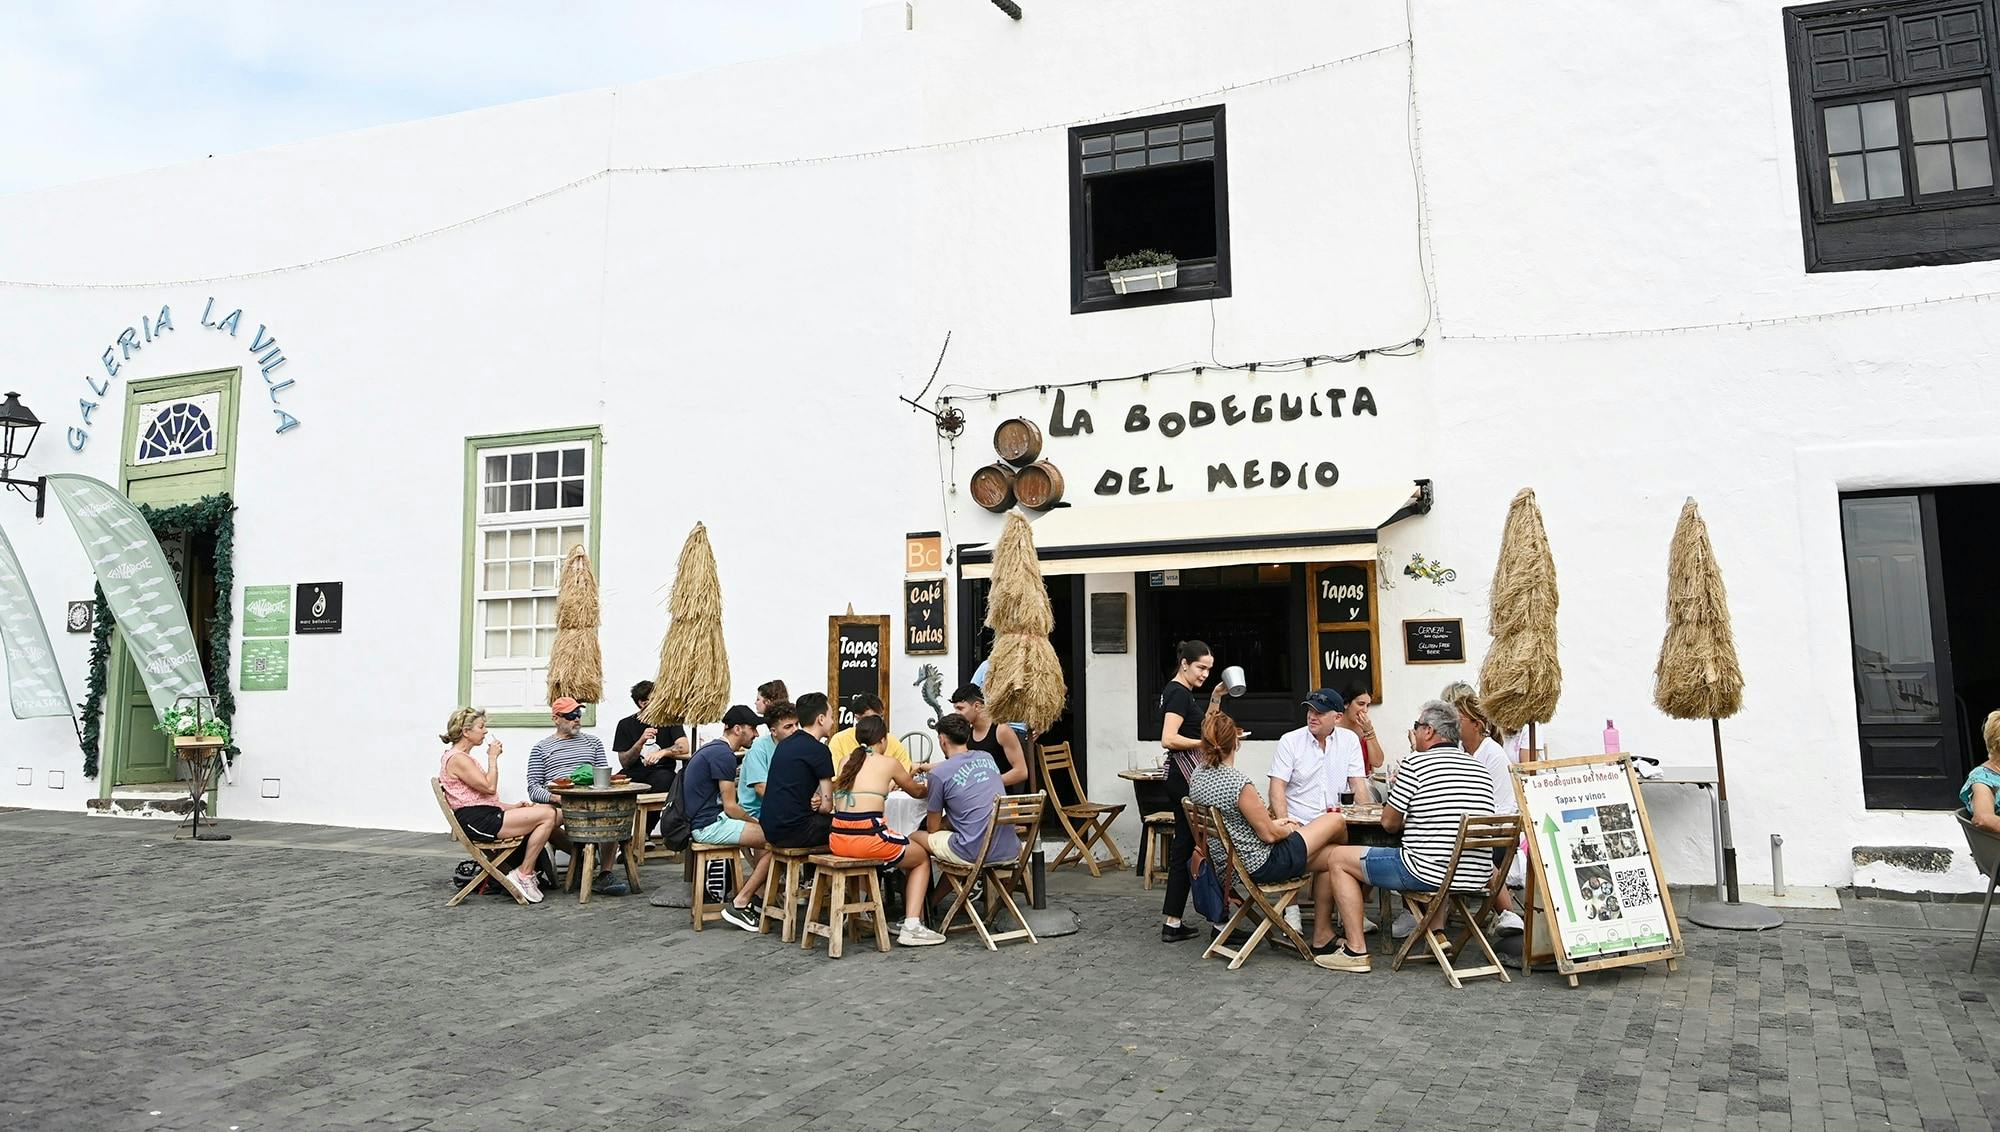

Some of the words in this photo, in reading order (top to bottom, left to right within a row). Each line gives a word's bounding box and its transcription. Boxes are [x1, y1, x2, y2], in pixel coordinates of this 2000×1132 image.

[66, 304, 174, 452] GALERIA
[201, 297, 242, 336] LA
[249, 323, 301, 434] VILLA
[1049, 388, 1093, 436] LA
[1124, 386, 1378, 437] BODEGUITA
[1094, 465, 1174, 496] DEL
[1207, 459, 1339, 492] MEDIO
[908, 541, 939, 568] Bc
[107, 556, 153, 579] LANZAROTE
[911, 582, 941, 605] Café
[1322, 580, 1364, 603] Tapas
[923, 608, 931, 621] y
[1349, 607, 1360, 620] y
[910, 625, 943, 643] Tartas
[840, 636, 878, 658] Tapas
[145, 649, 196, 674] LANZAROTE
[841, 660, 868, 670] para
[870, 658, 877, 668] 2
[1325, 650, 1367, 670] Vinos
[1532, 780, 1542, 789] La
[1596, 772, 1619, 782] Medio
[1555, 796, 1577, 805] Tapas
[1578, 795, 1584, 804] y
[1584, 792, 1606, 801] vinos
